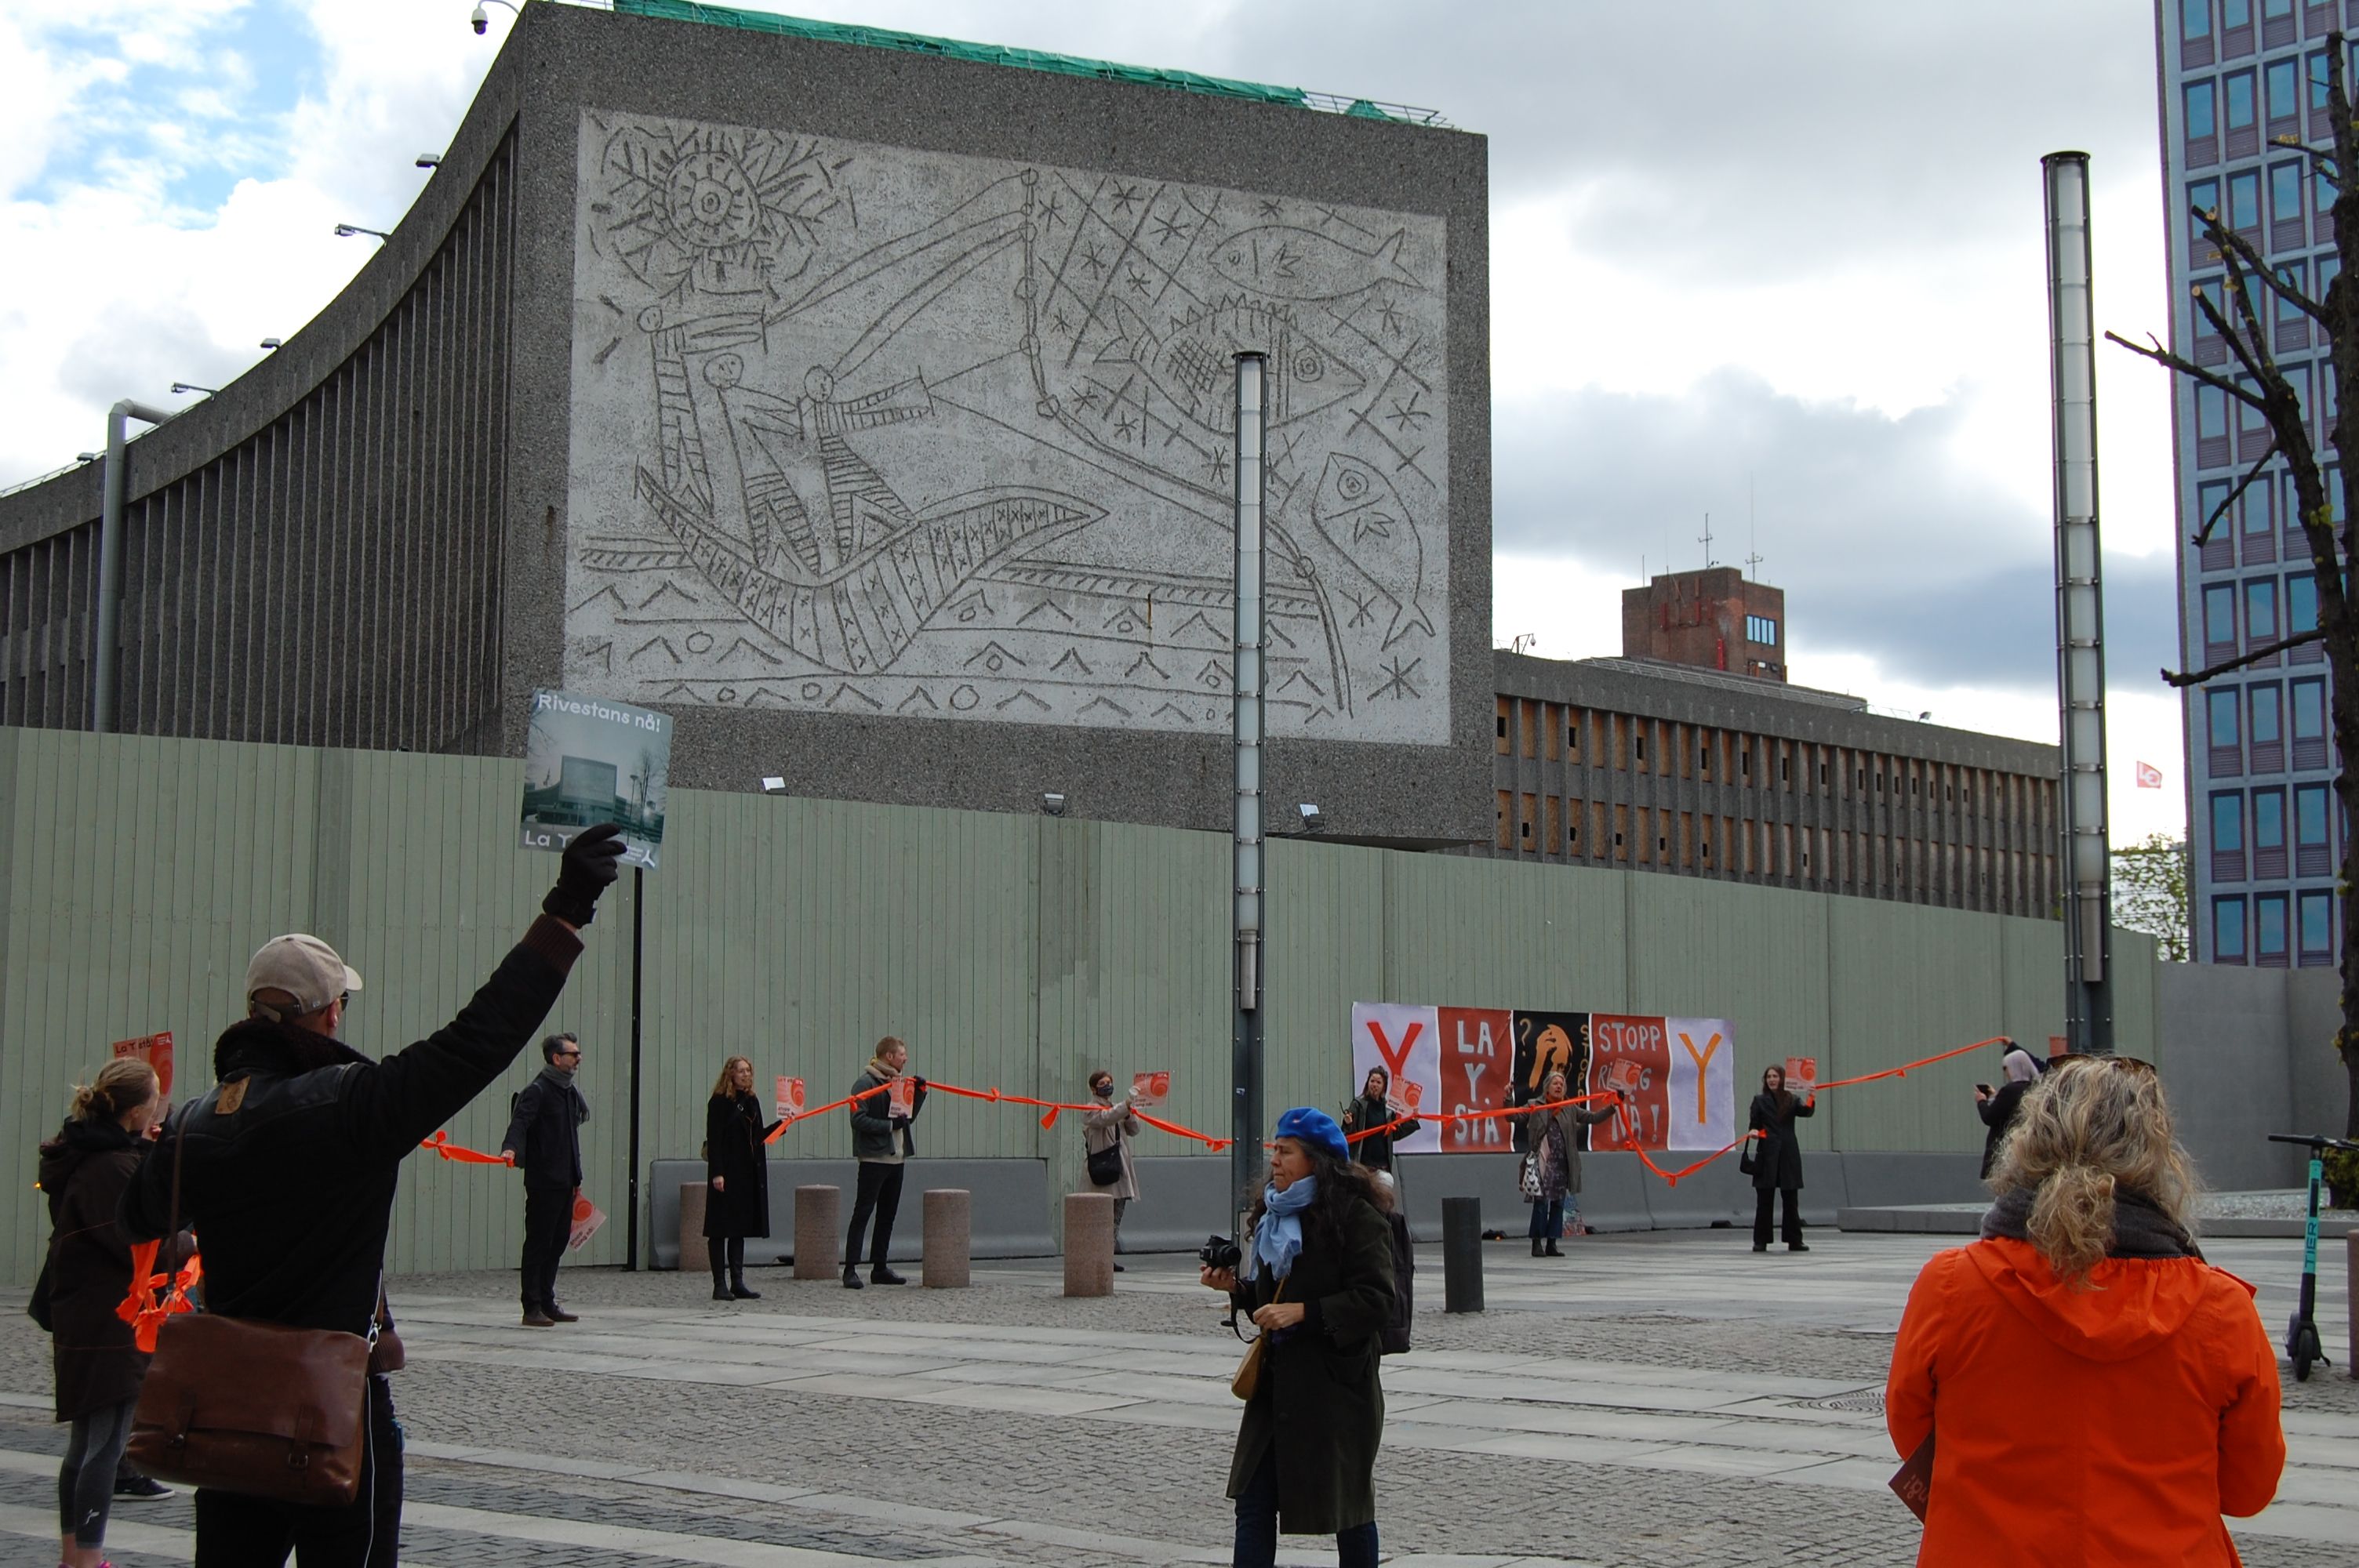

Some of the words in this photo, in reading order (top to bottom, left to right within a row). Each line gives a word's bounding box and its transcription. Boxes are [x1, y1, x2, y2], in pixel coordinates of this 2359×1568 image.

[538, 694, 630, 724] Rivestans
[635, 713, 661, 732] nå!
[525, 830, 551, 846] La
[1457, 1020, 1494, 1057] LA
[1599, 1022, 1661, 1052] STOPP
[1464, 1063, 1486, 1103] Y
[1678, 1033, 1722, 1124] Y
[2305, 1222, 2317, 1268] TIER
